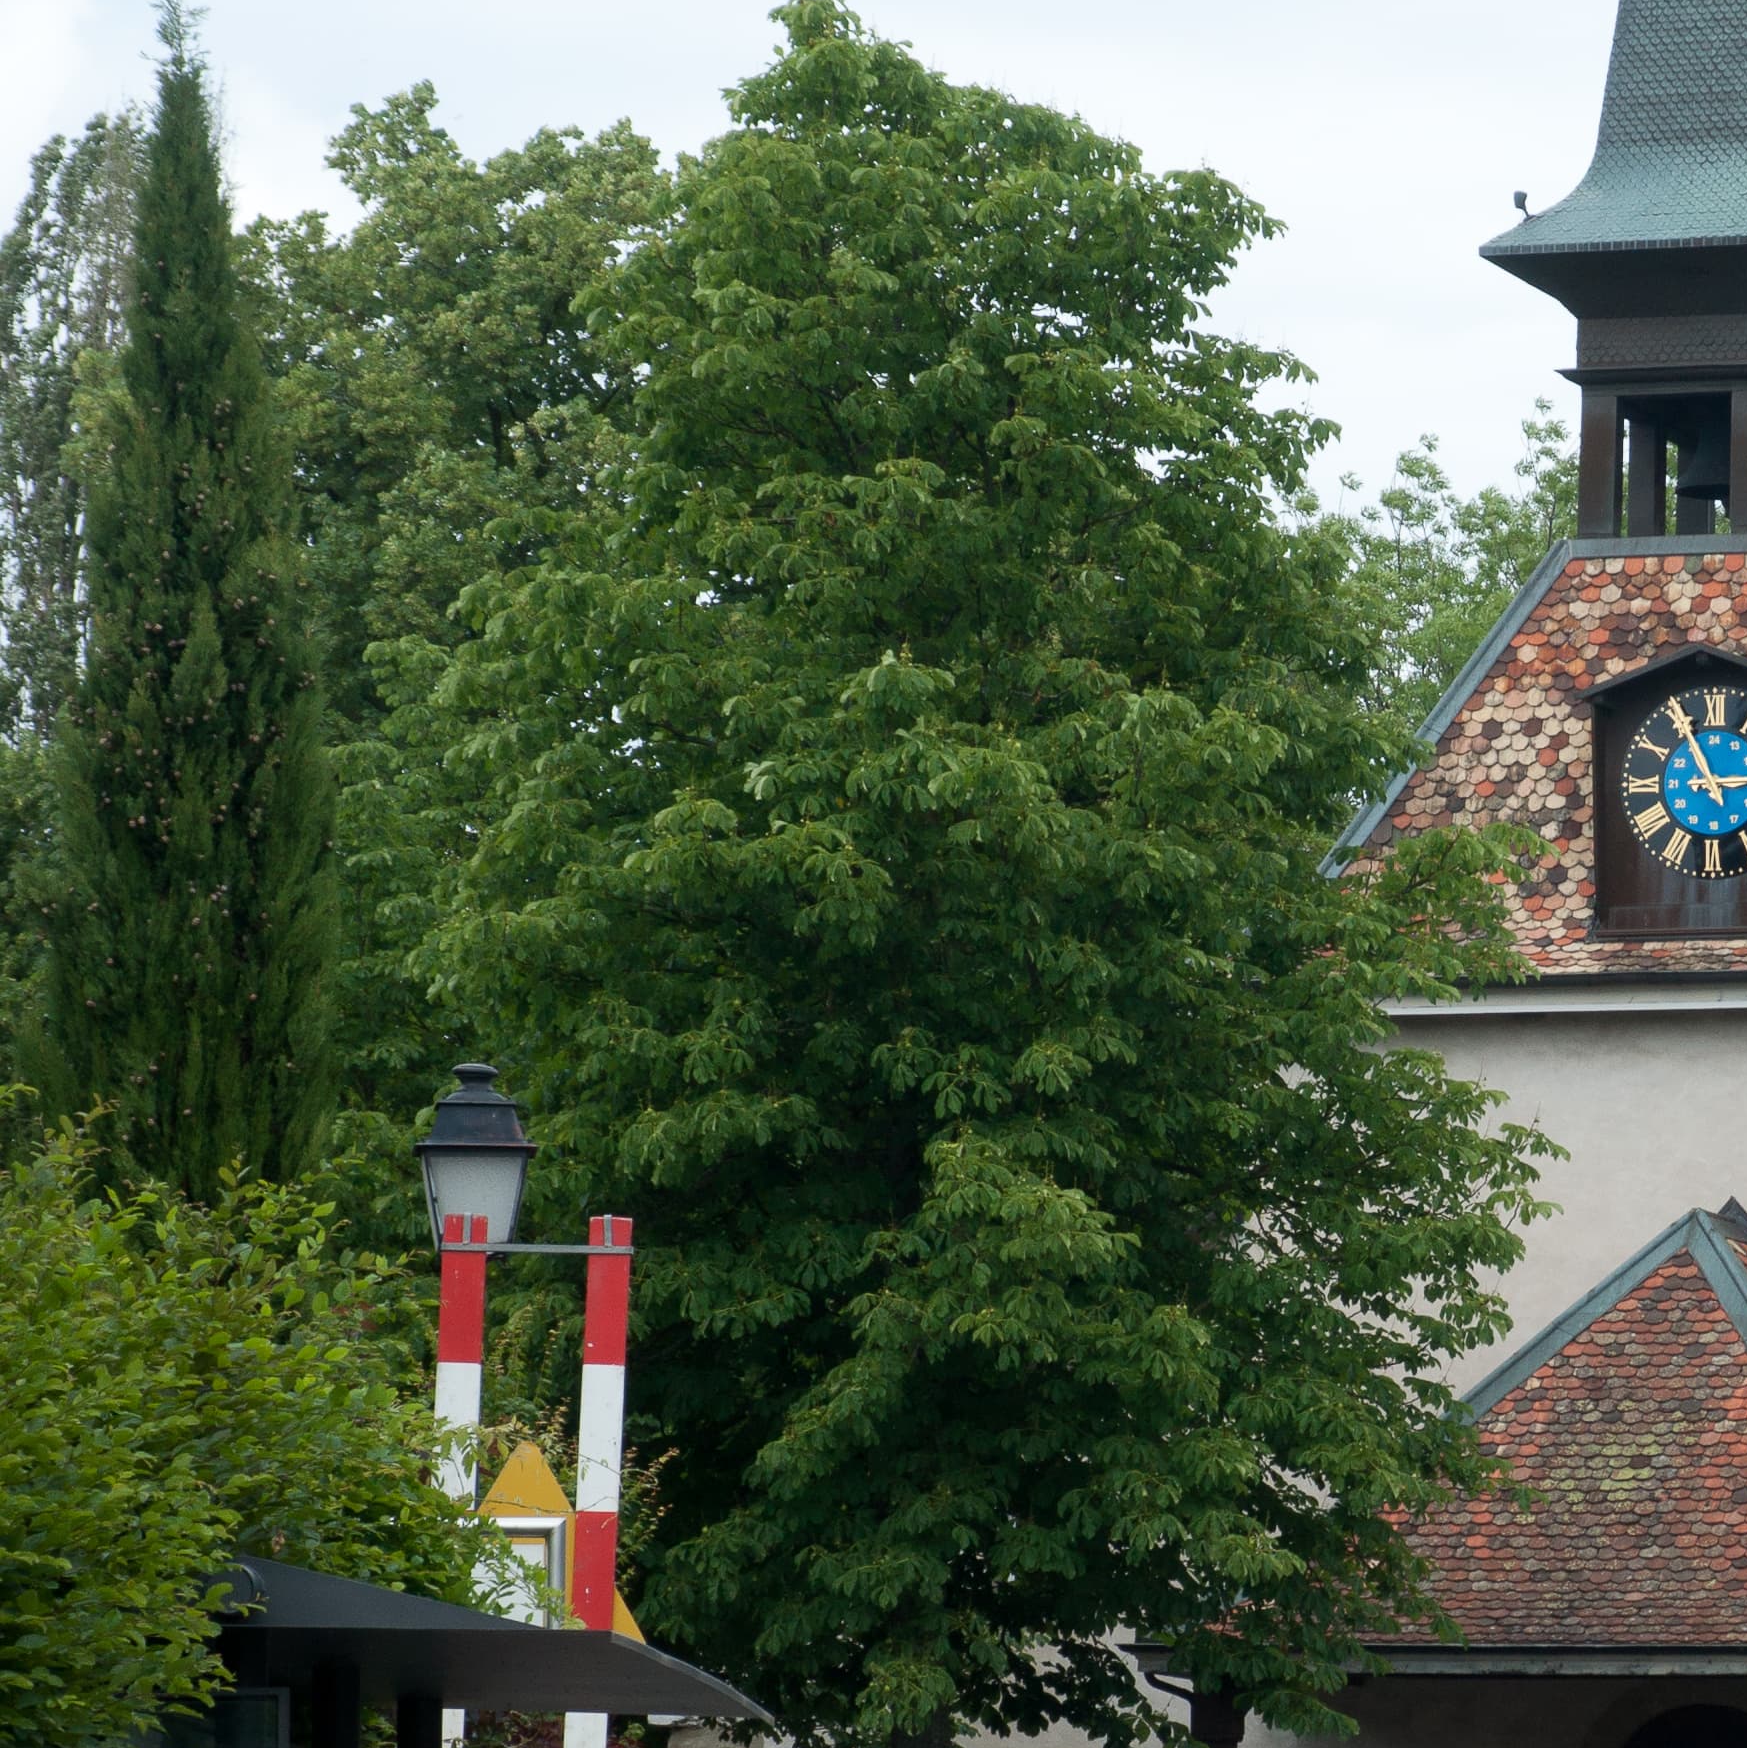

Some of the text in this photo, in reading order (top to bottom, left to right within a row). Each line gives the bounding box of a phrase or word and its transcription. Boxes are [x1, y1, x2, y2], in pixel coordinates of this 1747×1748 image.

[1704, 694, 1726, 726] XII
[1708, 734, 1720, 745] 24
[1638, 734, 1670, 761] X
[1729, 740, 1740, 751] 13
[1673, 758, 1686, 768] 22
[1629, 774, 1659, 793] IX
[1668, 779, 1679, 789] 21
[1674, 799, 1686, 809] 20
[1688, 814, 1698, 825] 19
[1729, 814, 1739, 824] 17
[1709, 820, 1719, 830] 18
[1662, 828, 1692, 865] VII
[1704, 840, 1722, 871] VI
